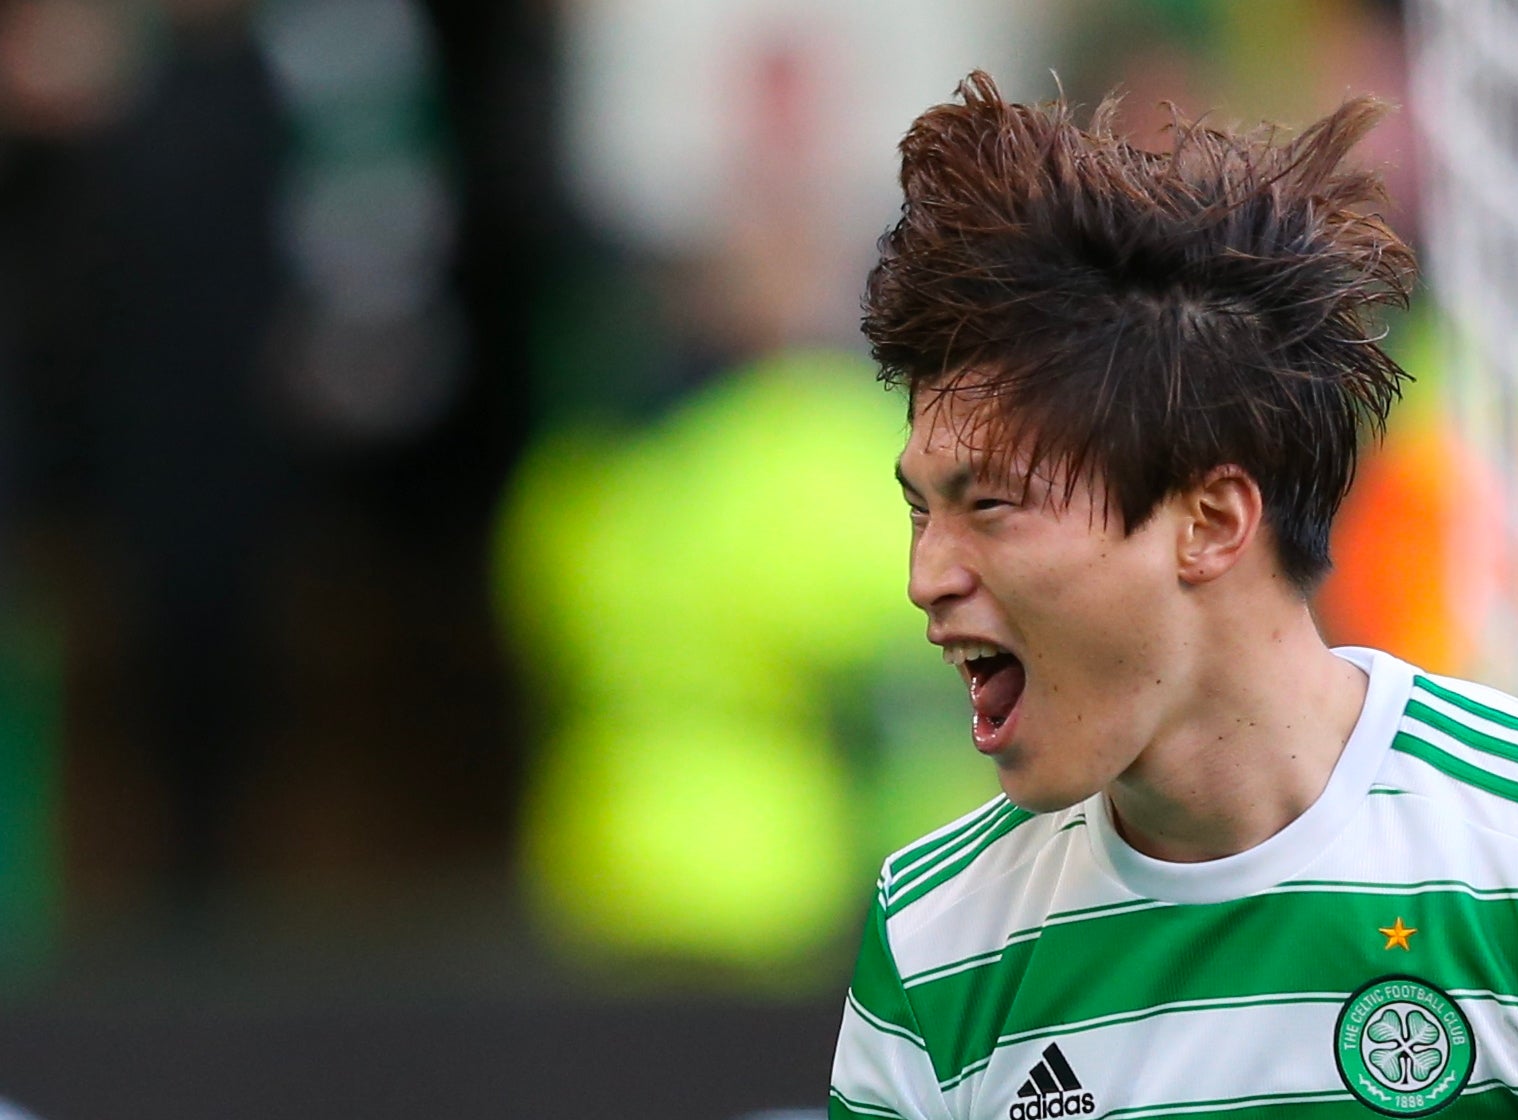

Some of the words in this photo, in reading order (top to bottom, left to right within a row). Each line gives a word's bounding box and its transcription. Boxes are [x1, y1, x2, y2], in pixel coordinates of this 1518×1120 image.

[1351, 989, 1384, 1023] CELTIC
[1385, 985, 1445, 1014] FOOTBALL
[1344, 1023, 1359, 1050] THE
[1443, 1011, 1465, 1045] CLUB
[1395, 1094, 1424, 1108] 1888
